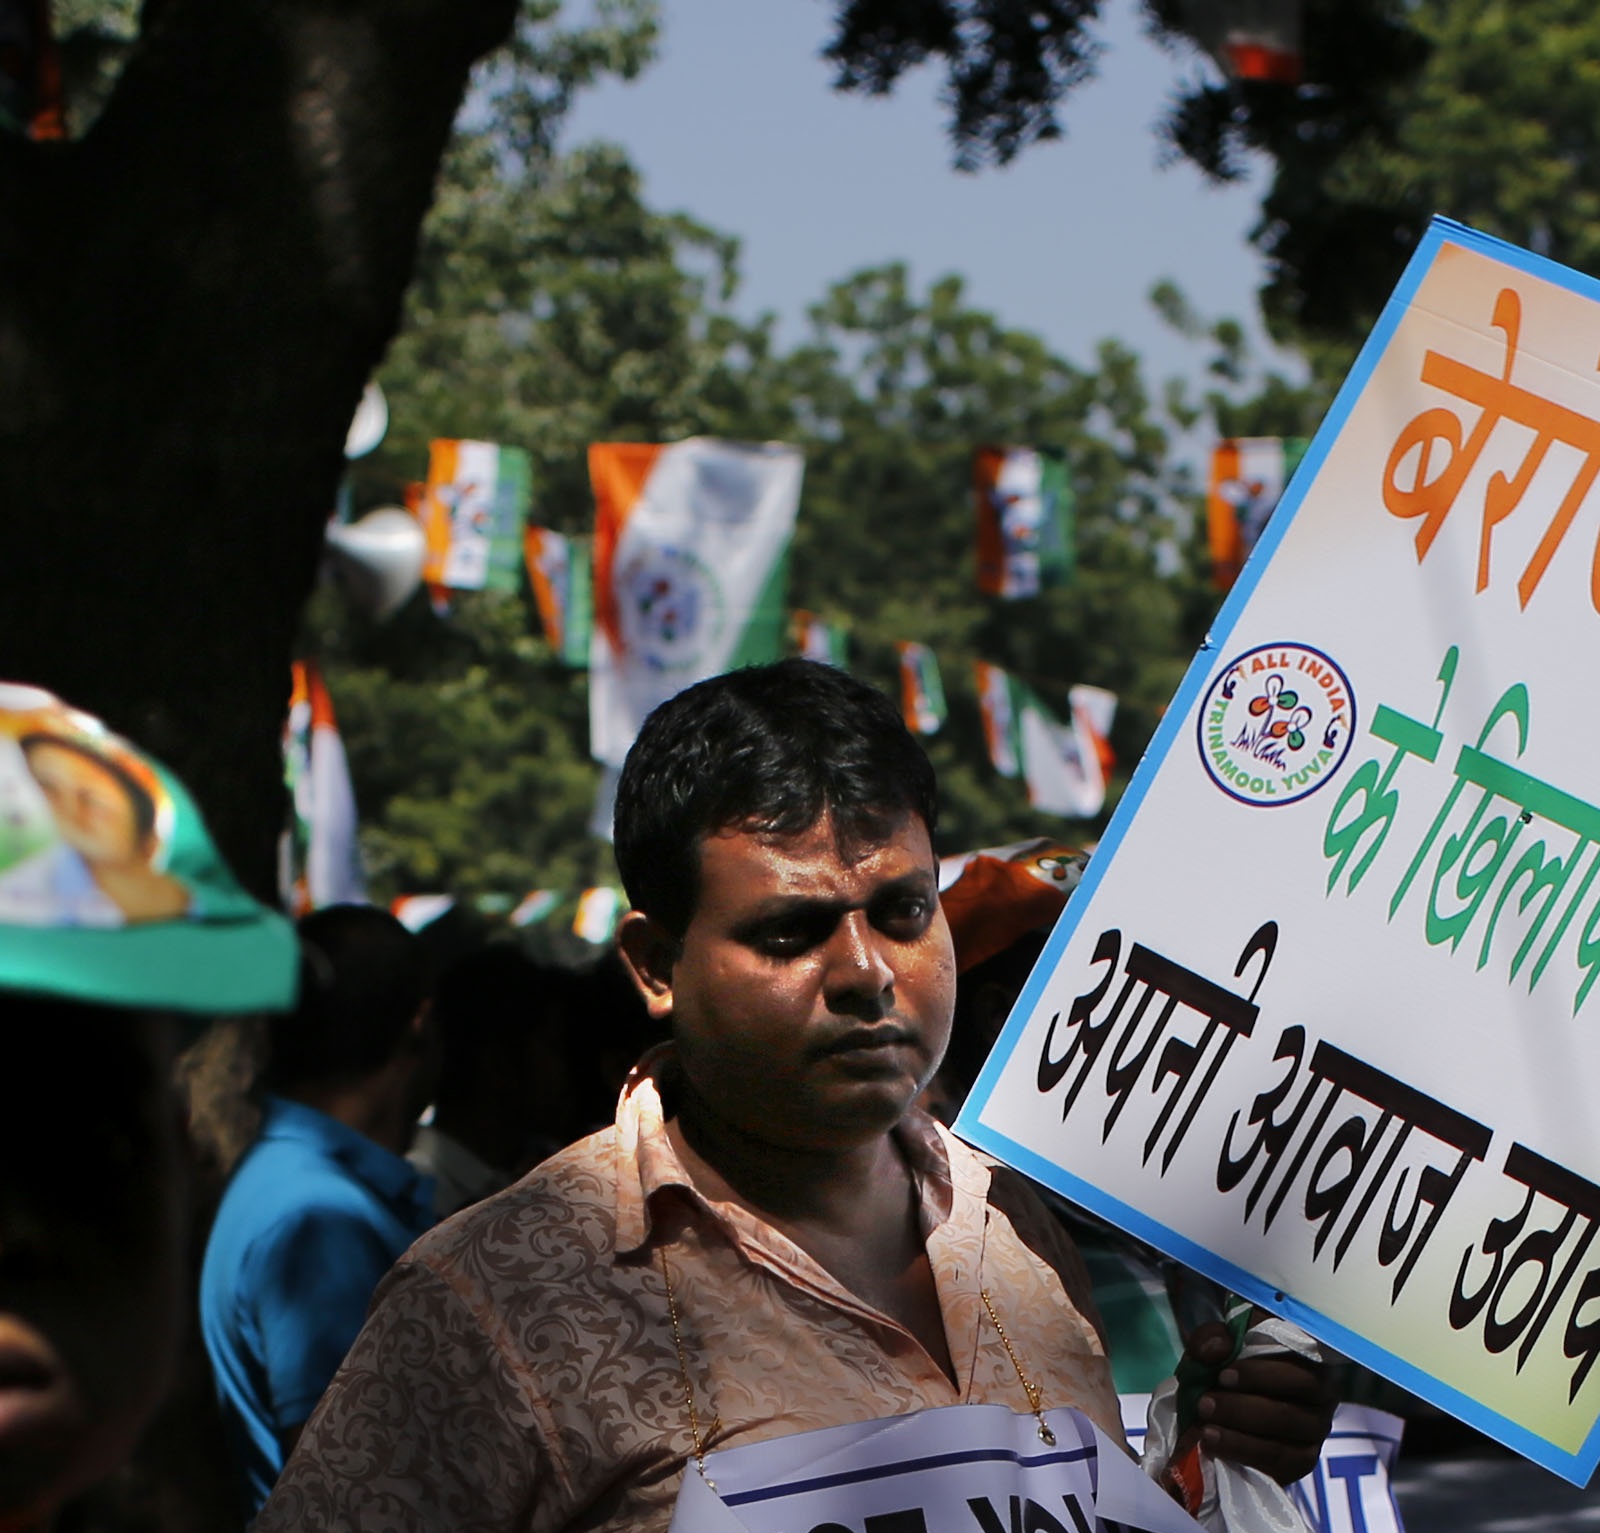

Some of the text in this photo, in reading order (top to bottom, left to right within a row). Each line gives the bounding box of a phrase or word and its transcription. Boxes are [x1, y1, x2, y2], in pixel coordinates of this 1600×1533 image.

[1208, 699, 1333, 794] TRINAMOOL YUVA
[1251, 653, 1345, 712] ALL INDIA
[1323, 645, 1459, 898] के
[1037, 921, 1278, 1178] अपनी
[1216, 1025, 1493, 1306] आवाज
